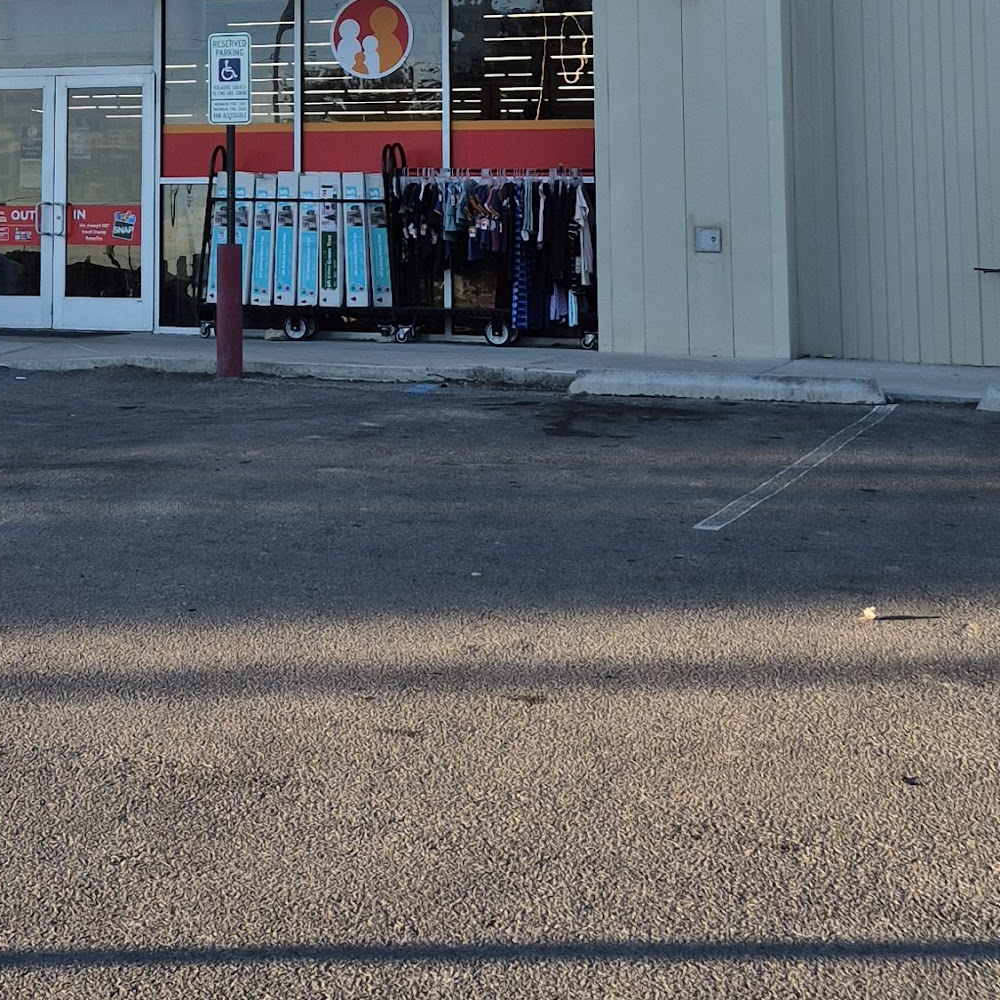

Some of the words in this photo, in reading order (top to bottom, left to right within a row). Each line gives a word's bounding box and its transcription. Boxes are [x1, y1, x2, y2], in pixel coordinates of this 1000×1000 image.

[212, 39, 247, 48] RESERVED
[215, 49, 244, 57] PARKING
[10, 210, 36, 221] OUT
[73, 209, 86, 220] IN
[112, 226, 134, 235] SNAP
